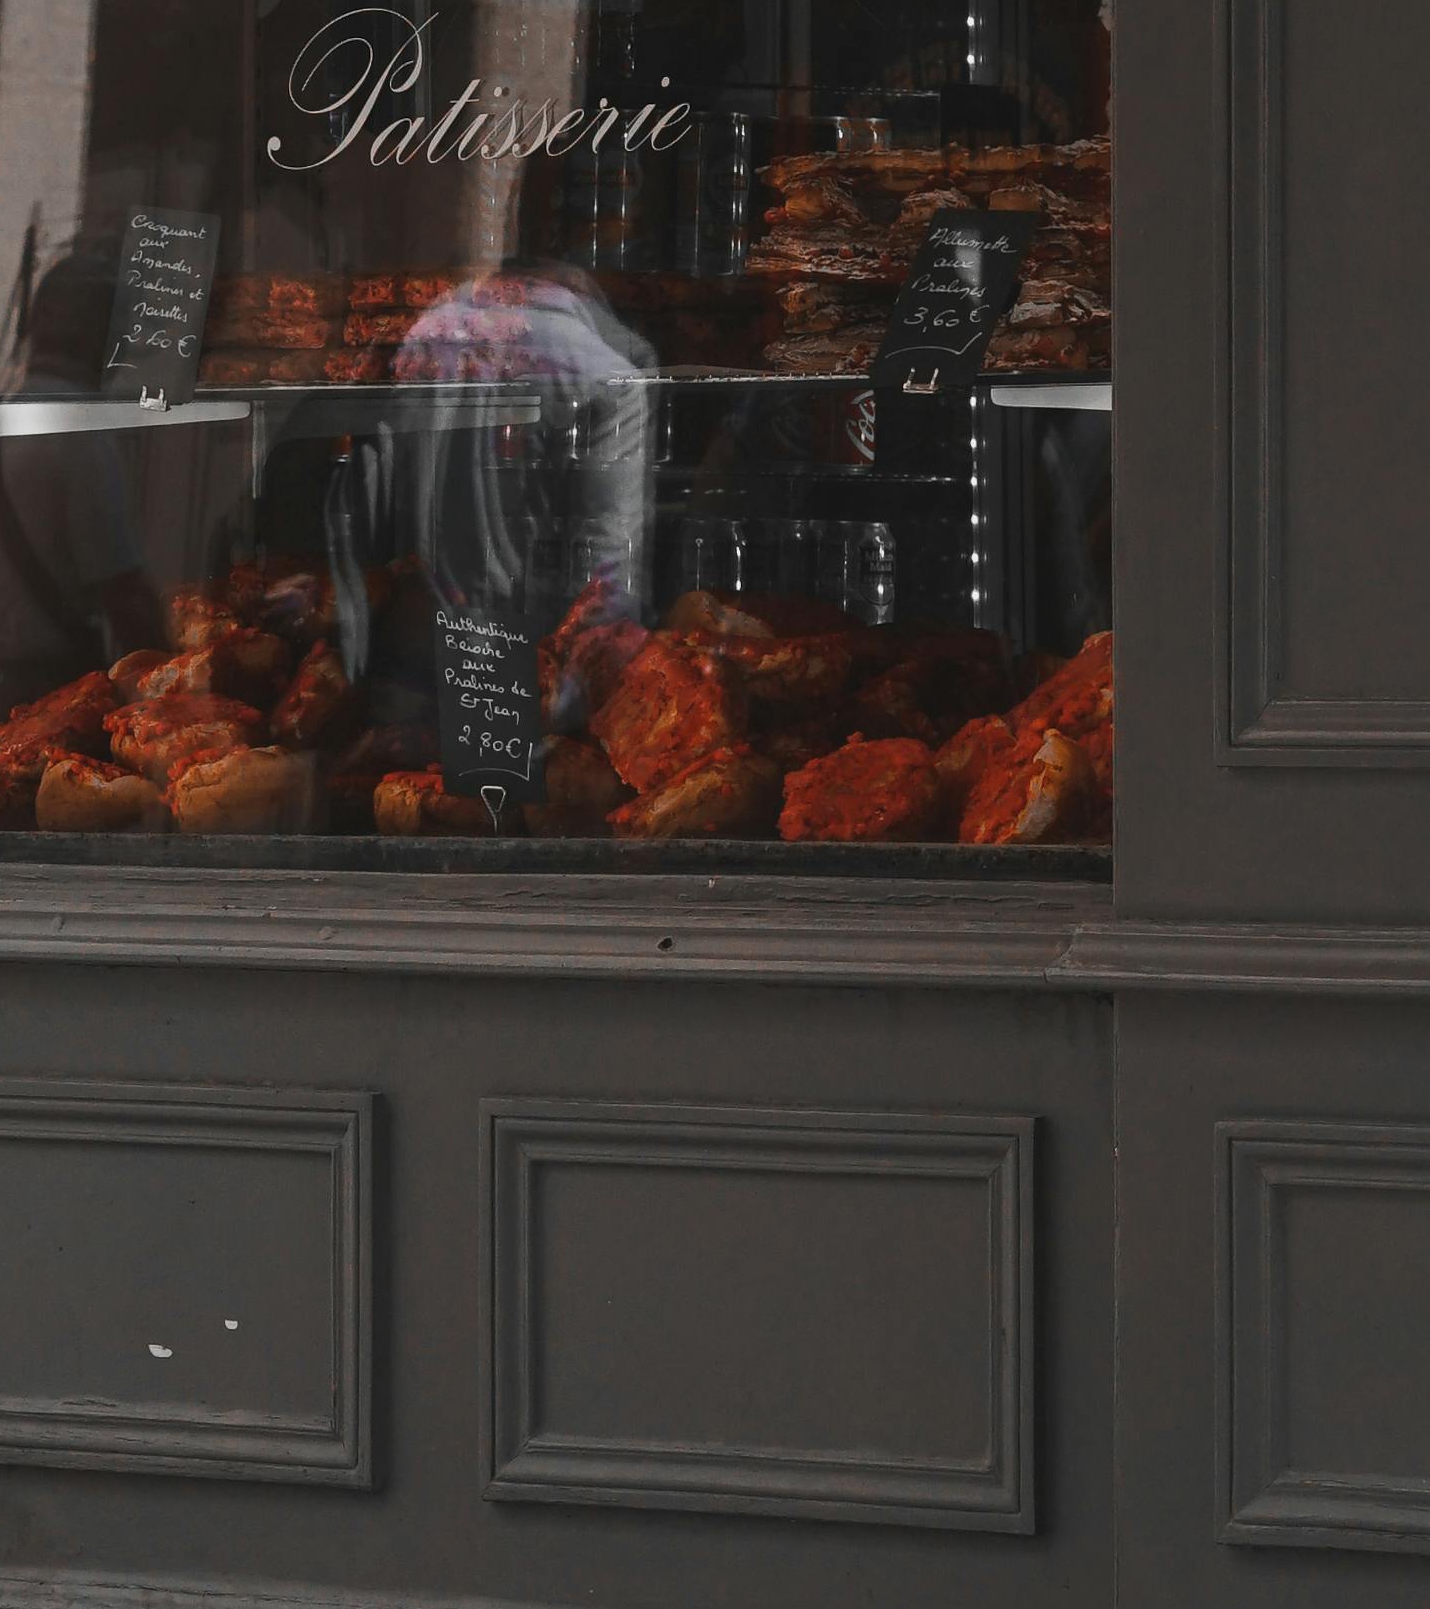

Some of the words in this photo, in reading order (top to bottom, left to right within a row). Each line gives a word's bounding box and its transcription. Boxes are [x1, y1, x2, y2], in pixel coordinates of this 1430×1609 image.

[130, 214, 208, 240] Croquant
[138, 237, 170, 249] aux
[933, 257, 975, 269] aux
[125, 270, 184, 296] Pralines
[188, 289, 205, 301] et
[910, 273, 988, 300] Pralines
[436, 610, 529, 650] Authentique
[444, 634, 506, 659] Brioche
[462, 660, 497, 673] aux
[444, 667, 505, 694] Pralines
[511, 681, 534, 698] de
[482, 698, 521, 726] Jean
